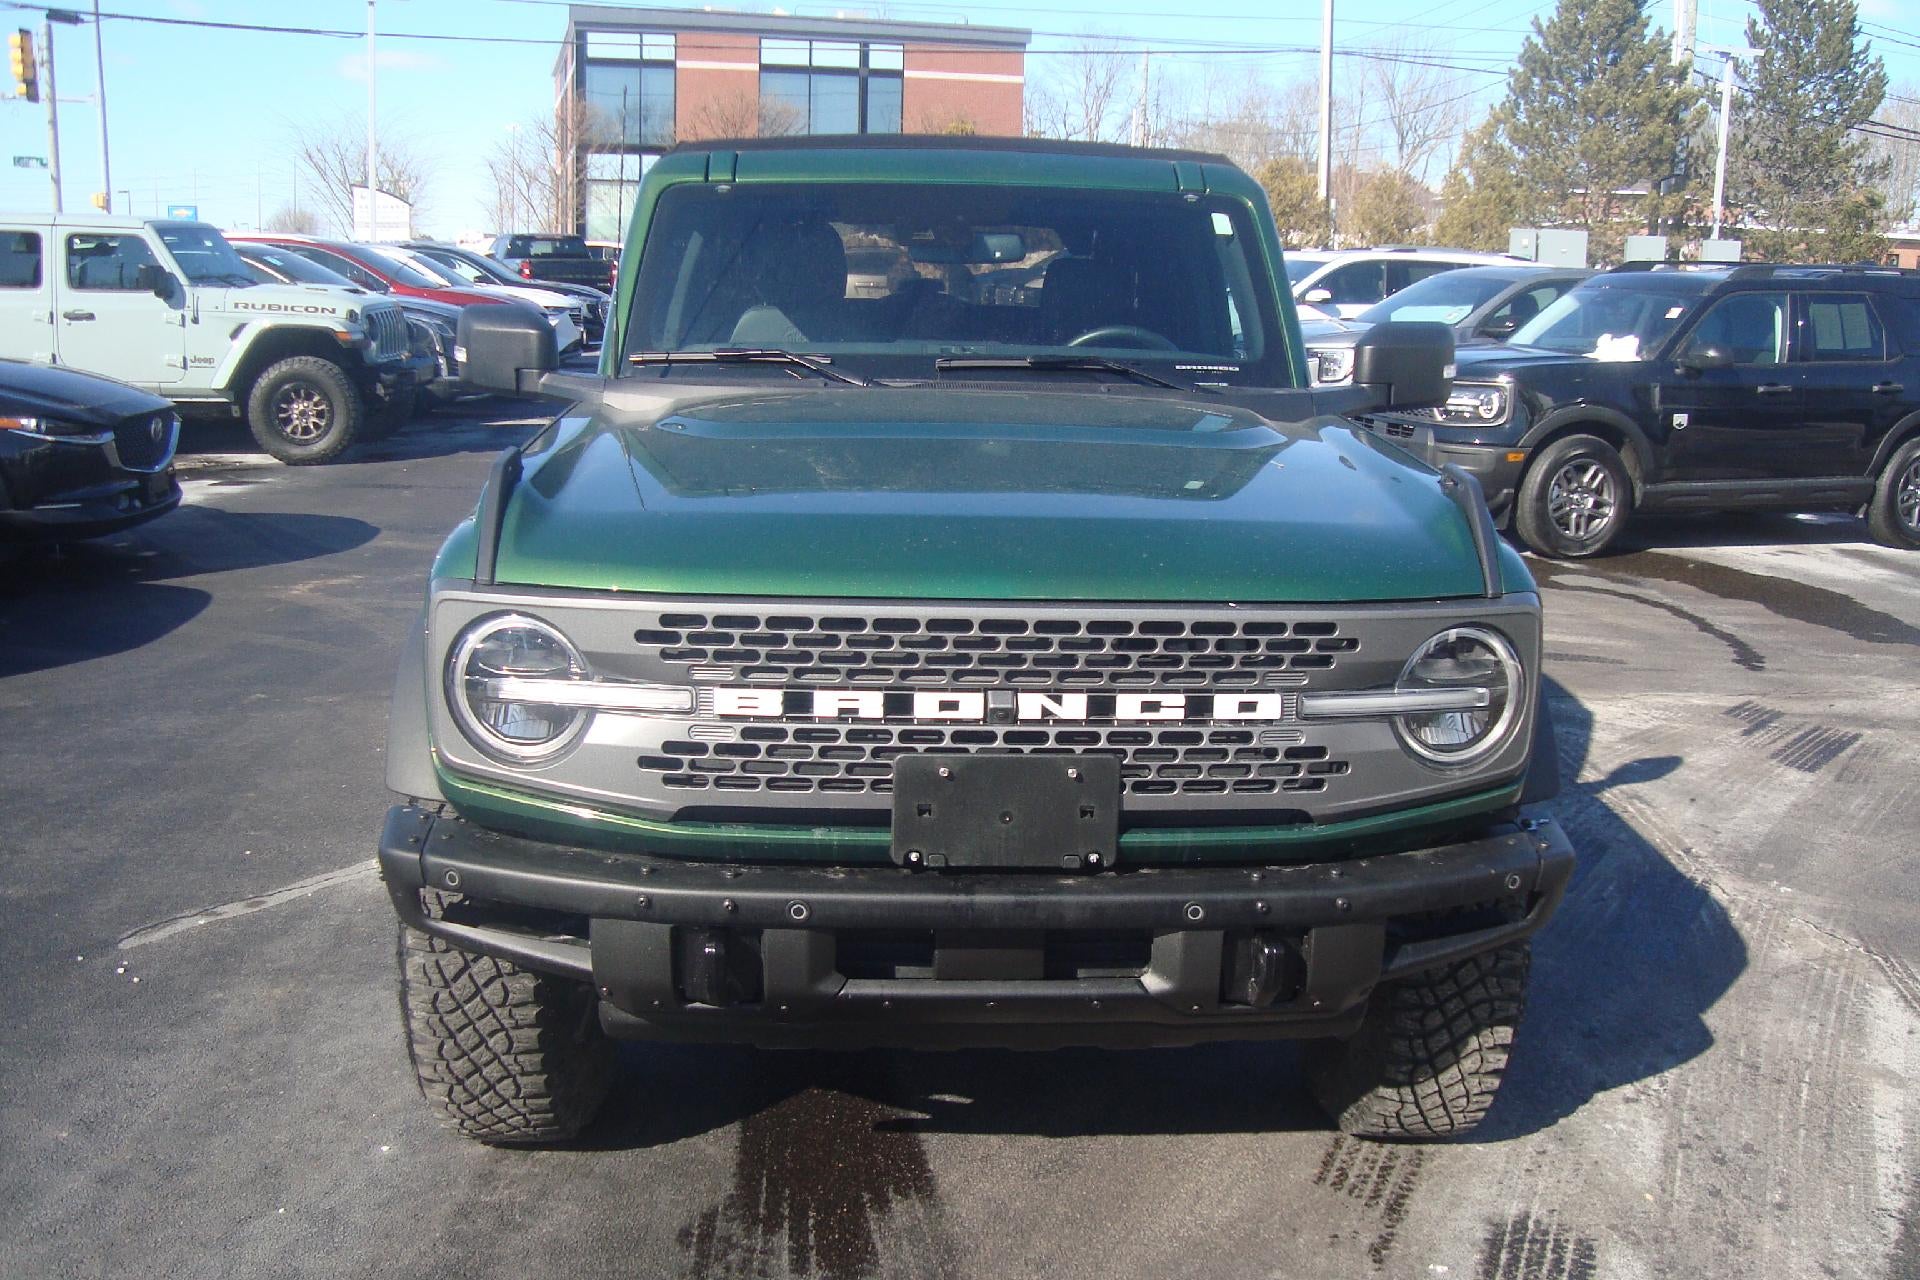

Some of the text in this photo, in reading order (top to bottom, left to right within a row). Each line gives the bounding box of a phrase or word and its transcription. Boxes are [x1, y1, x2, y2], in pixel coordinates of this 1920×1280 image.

[233, 302, 337, 315] RUBICON
[190, 355, 215, 365] Jeep
[713, 687, 1282, 721] BRONCO
